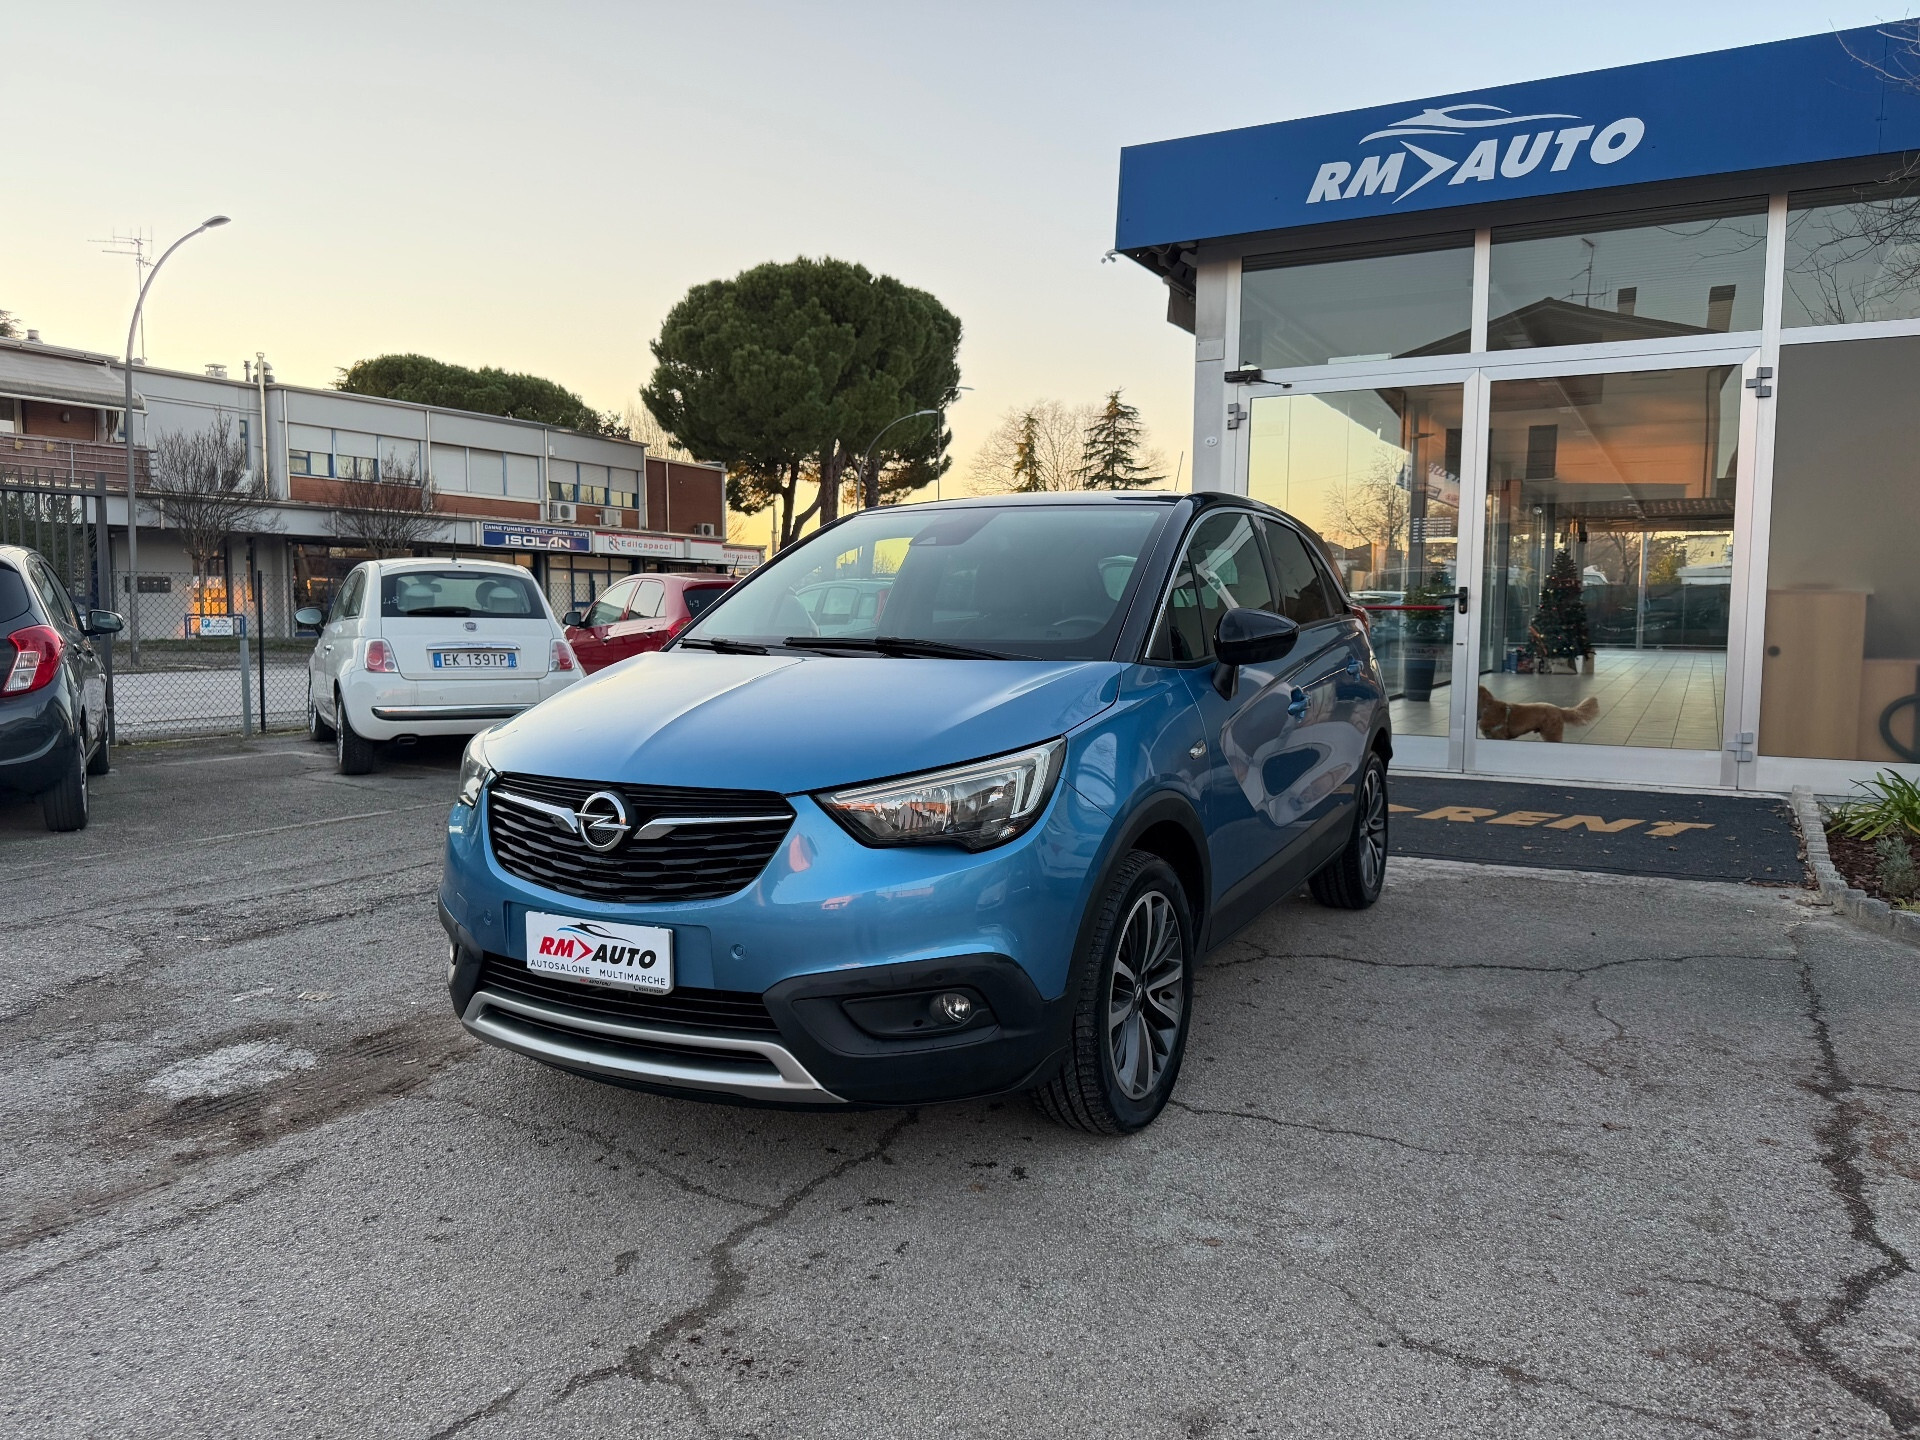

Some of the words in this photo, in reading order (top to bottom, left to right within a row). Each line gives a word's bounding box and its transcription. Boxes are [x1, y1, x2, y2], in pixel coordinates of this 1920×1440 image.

[1305, 151, 1406, 204] RM
[1447, 116, 1646, 186] AUTO
[505, 534, 571, 549] ISOLAN
[621, 540, 673, 550] Edilcapacci
[689, 599, 700, 608] 49
[443, 653, 461, 666] EK
[466, 653, 507, 666] 139TP
[1413, 805, 1716, 837] RENT
[539, 936, 575, 958] RM
[591, 943, 657, 969] AUTO
[530, 959, 591, 975] AUTOSALONE
[599, 968, 666, 986] MULTIMARCHE
